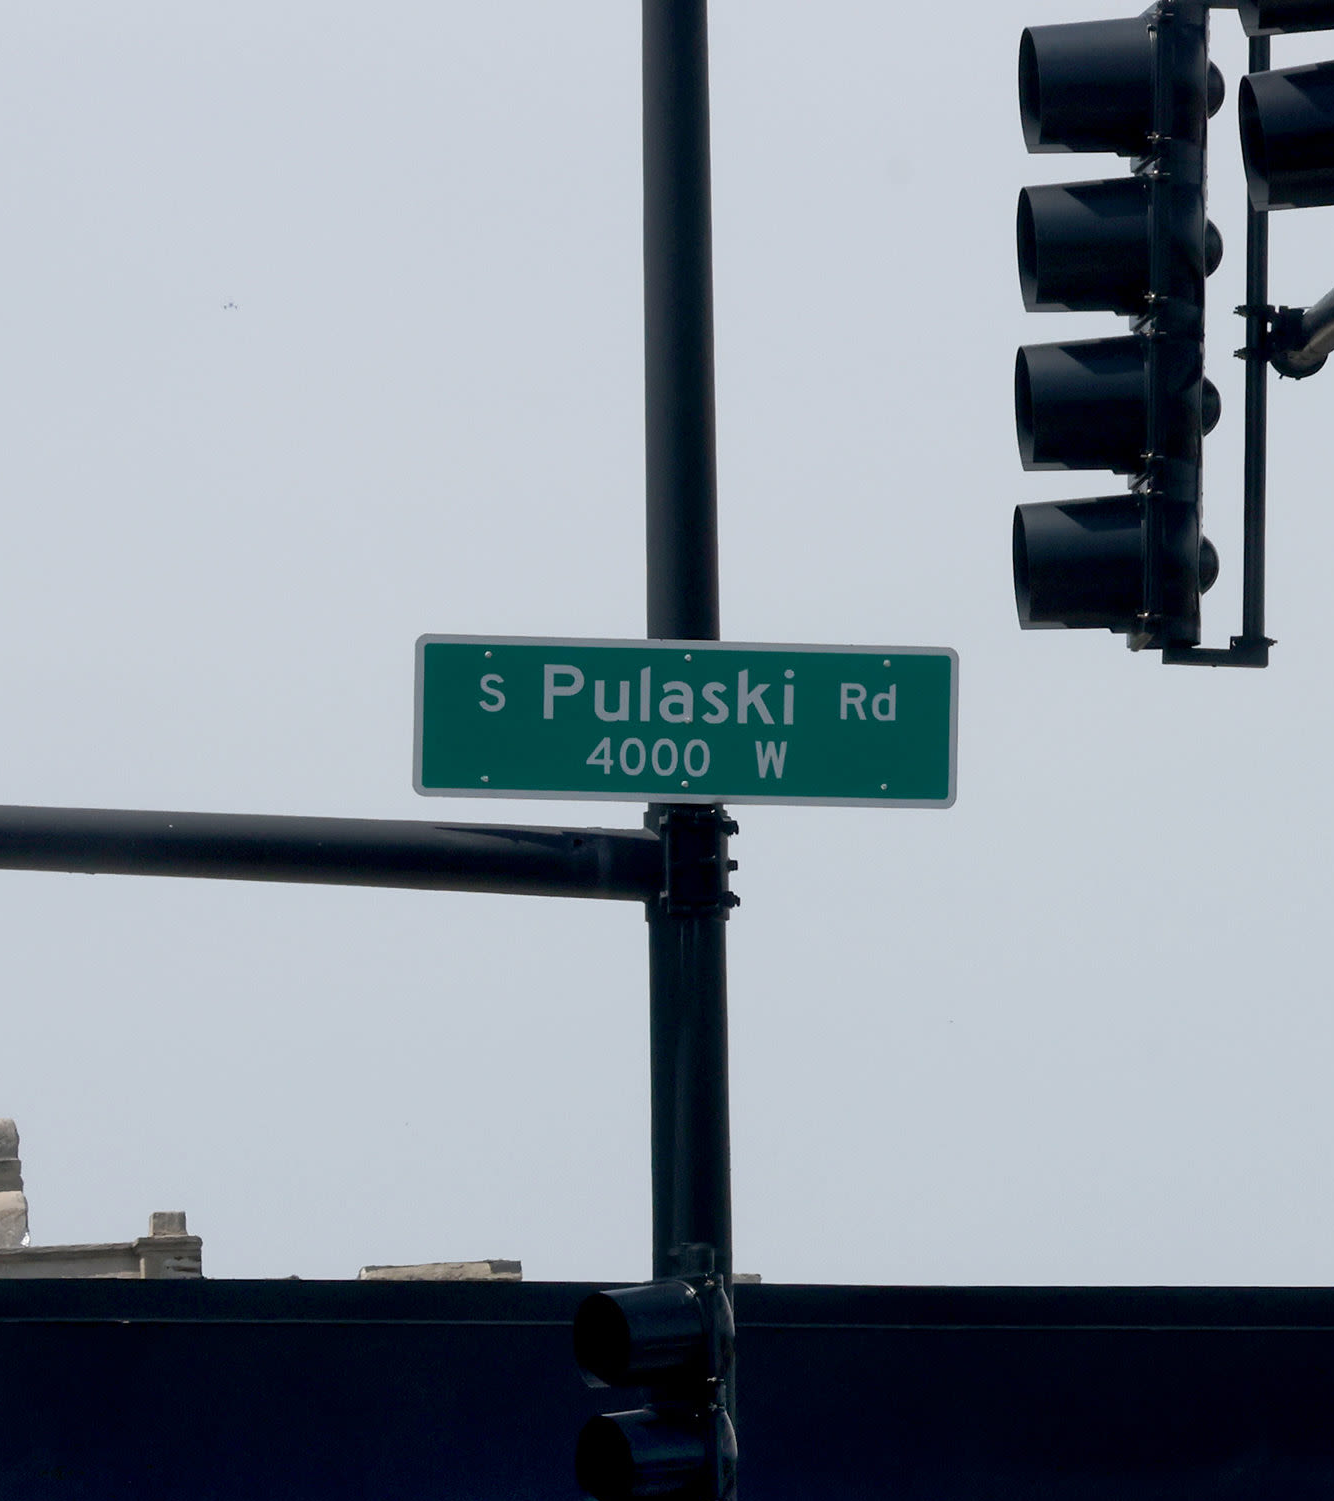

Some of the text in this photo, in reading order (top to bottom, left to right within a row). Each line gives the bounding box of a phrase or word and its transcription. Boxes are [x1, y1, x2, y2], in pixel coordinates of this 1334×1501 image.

[479, 663, 897, 725] S Pulaski Rd
[586, 737, 788, 778] 4000 W
